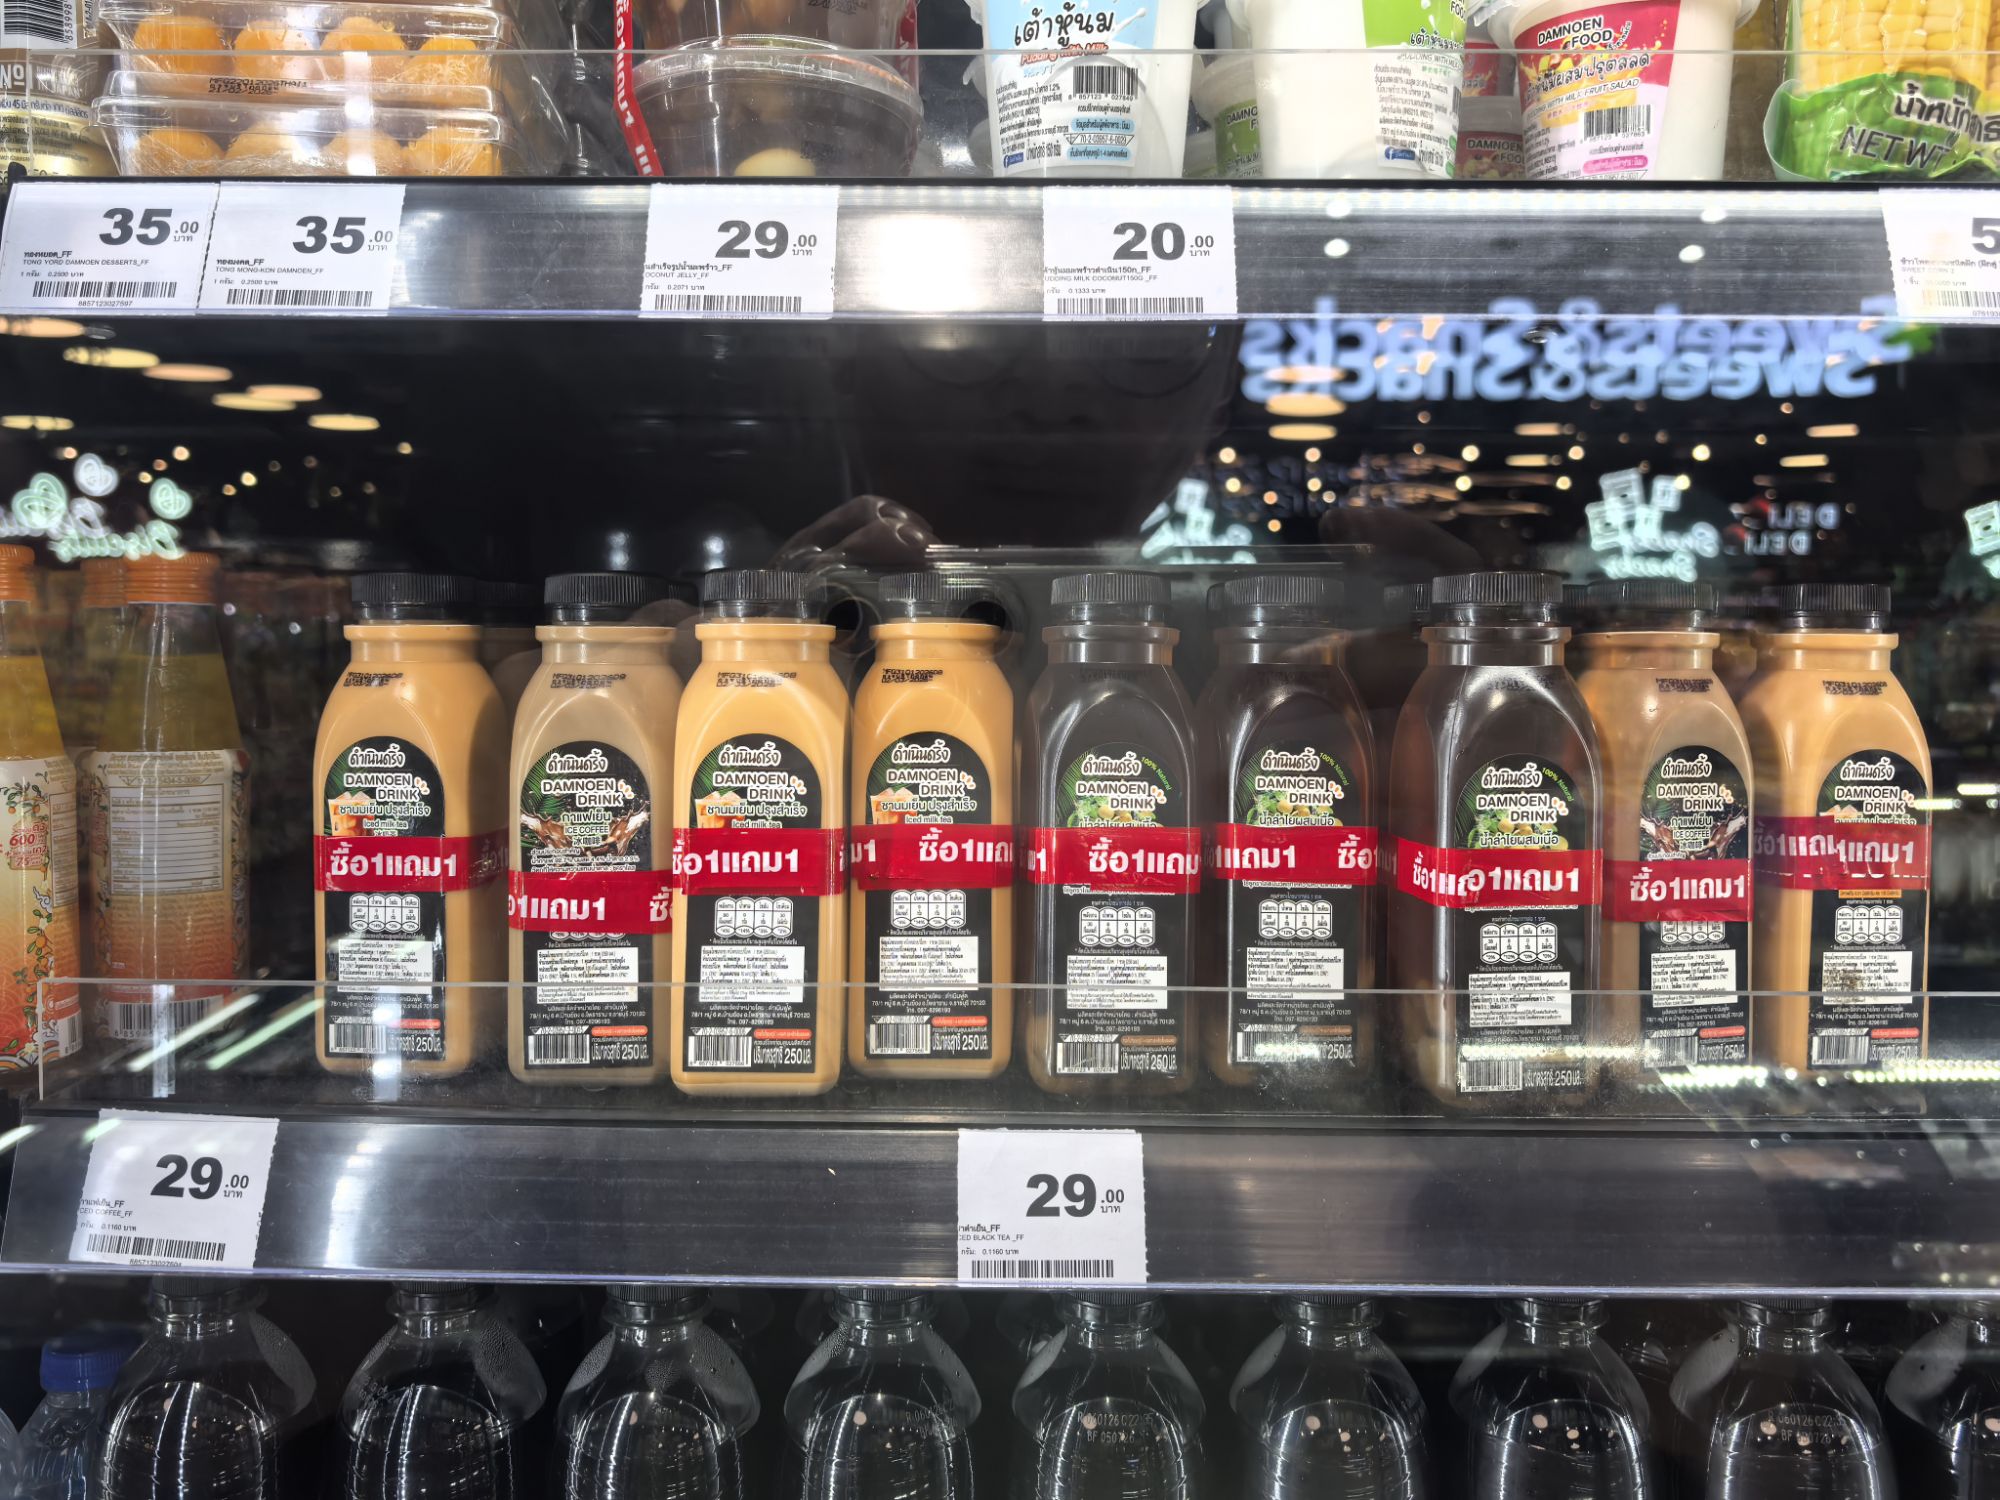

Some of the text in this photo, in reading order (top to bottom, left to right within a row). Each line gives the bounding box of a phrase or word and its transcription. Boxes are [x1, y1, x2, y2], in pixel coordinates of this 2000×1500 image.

[1014, 1, 1114, 47] เต้าหู้นม
[1537, 16, 1603, 45] DAMNOEN
[1571, 30, 1613, 49] FOOD
[1610, 78, 1640, 92] SALAD
[1840, 127, 1903, 161] NET
[173, 234, 193, 242] บาท
[367, 243, 388, 252] บาท
[791, 248, 813, 257] บาท
[1189, 249, 1210, 257] บาท
[345, 774, 412, 786] DAMNOEN
[714, 774, 787, 786] DAMNOEN
[887, 770, 956, 782] DAMNOEN
[1541, 767, 1558, 781] 100%
[543, 780, 614, 792] DAMNOEN
[1077, 782, 1148, 794] DAMNOEN
[1257, 777, 1325, 789] DAMNOEN
[377, 789, 419, 800] DRINK
[748, 788, 795, 800] DRINK
[920, 784, 965, 796] DRINK
[1657, 785, 1718, 797] DAMNOEN
[1836, 787, 1899, 800] DAMNOEN
[577, 793, 623, 806] DRINK
[1110, 798, 1155, 810] DRINK
[1289, 792, 1332, 804] DRINK
[1478, 795, 1548, 807] DAMNOEN
[1684, 798, 1723, 810] DRINK
[1864, 802, 1906, 814] DRINK
[562, 809, 612, 823] กาแฟเย็น
[906, 815, 922, 823] Iced
[924, 815, 939, 823] milk
[1510, 810, 1556, 822] DRINK
[1671, 813, 1712, 827] กาแฟเย็น
[565, 826, 609, 834] ICE COFFEE
[732, 820, 750, 828] Iced
[751, 820, 768, 828] milk
[1480, 831, 1558, 847] น้ำลำไยผสมเนื้อ
[1673, 830, 1710, 838] ICE COFFEE
[330, 842, 457, 877] ซื้อ1แถม1
[1630, 867, 1745, 902] ซื้อ1แถม1
[962, 1035, 980, 1050] 250
[621, 1044, 640, 1059] 250
[784, 1048, 803, 1065] 250
[1150, 1054, 1169, 1071] 250
[223, 1189, 243, 1199] บาท
[1100, 1205, 1121, 1214] บาท
